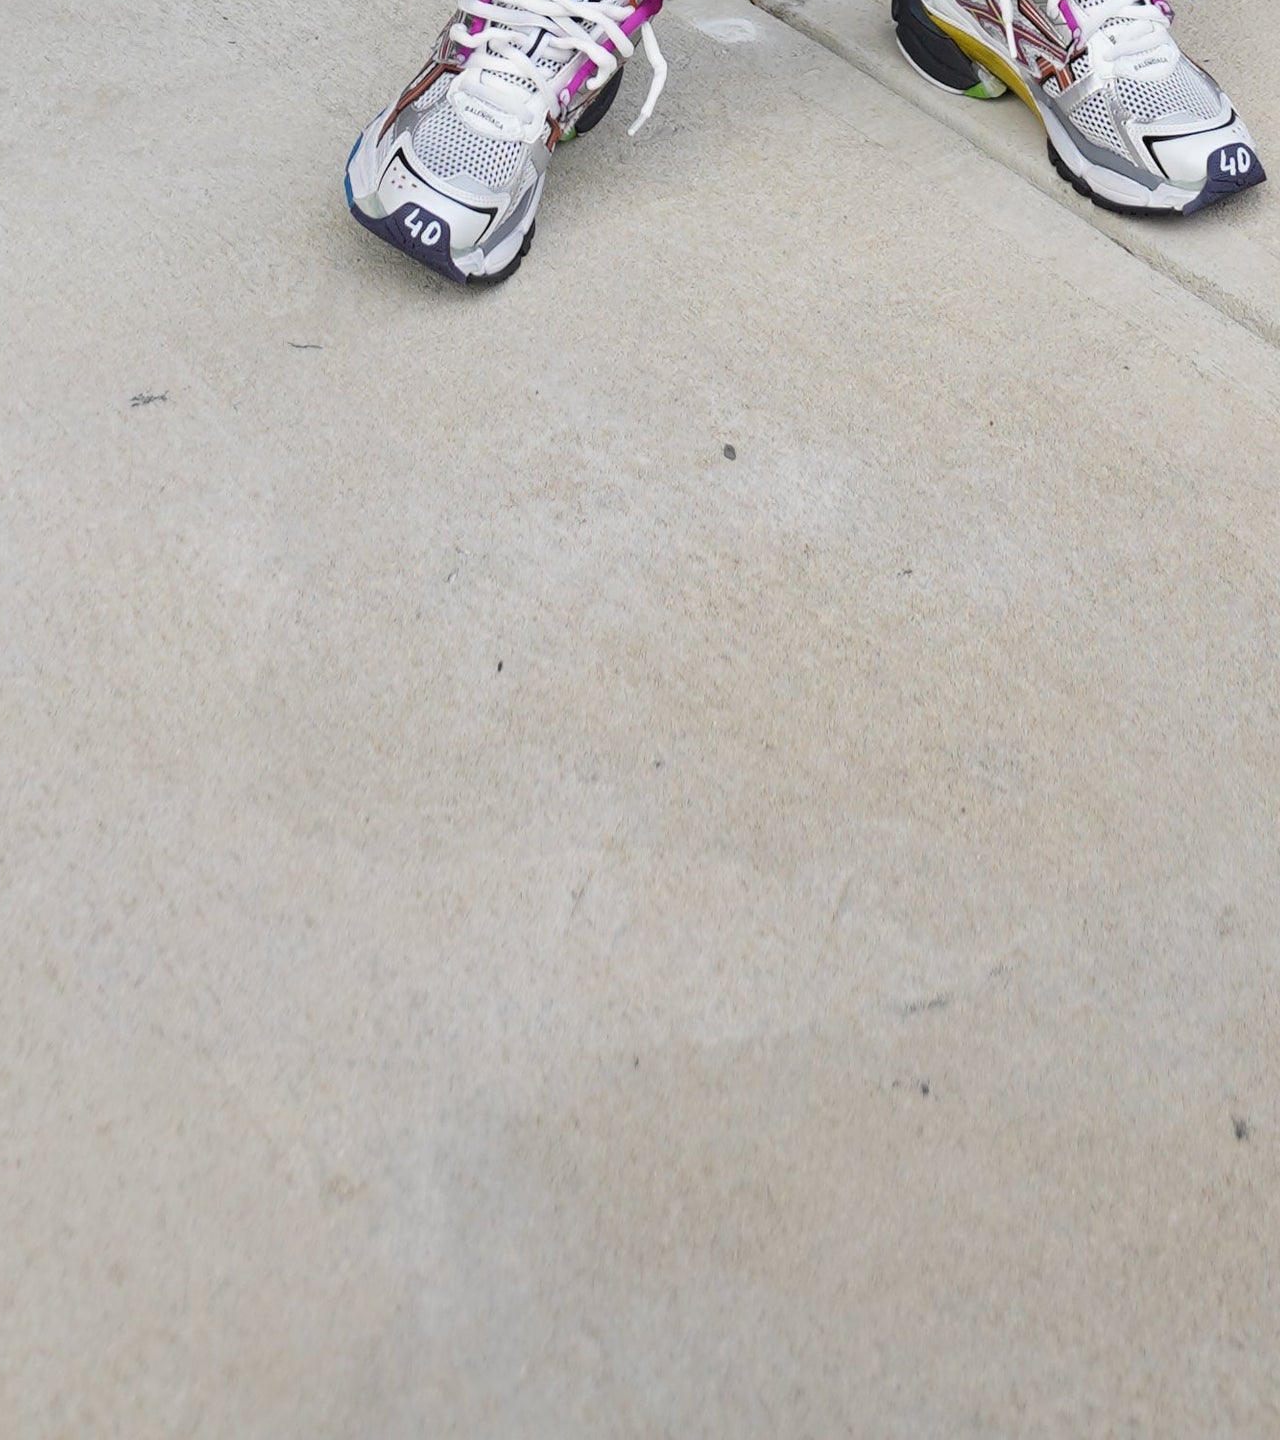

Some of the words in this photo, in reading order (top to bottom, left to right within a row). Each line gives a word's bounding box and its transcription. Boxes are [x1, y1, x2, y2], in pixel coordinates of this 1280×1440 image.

[464, 105, 504, 131] BALENCIAGA
[1220, 147, 1250, 176] 40
[404, 207, 442, 246] 40
